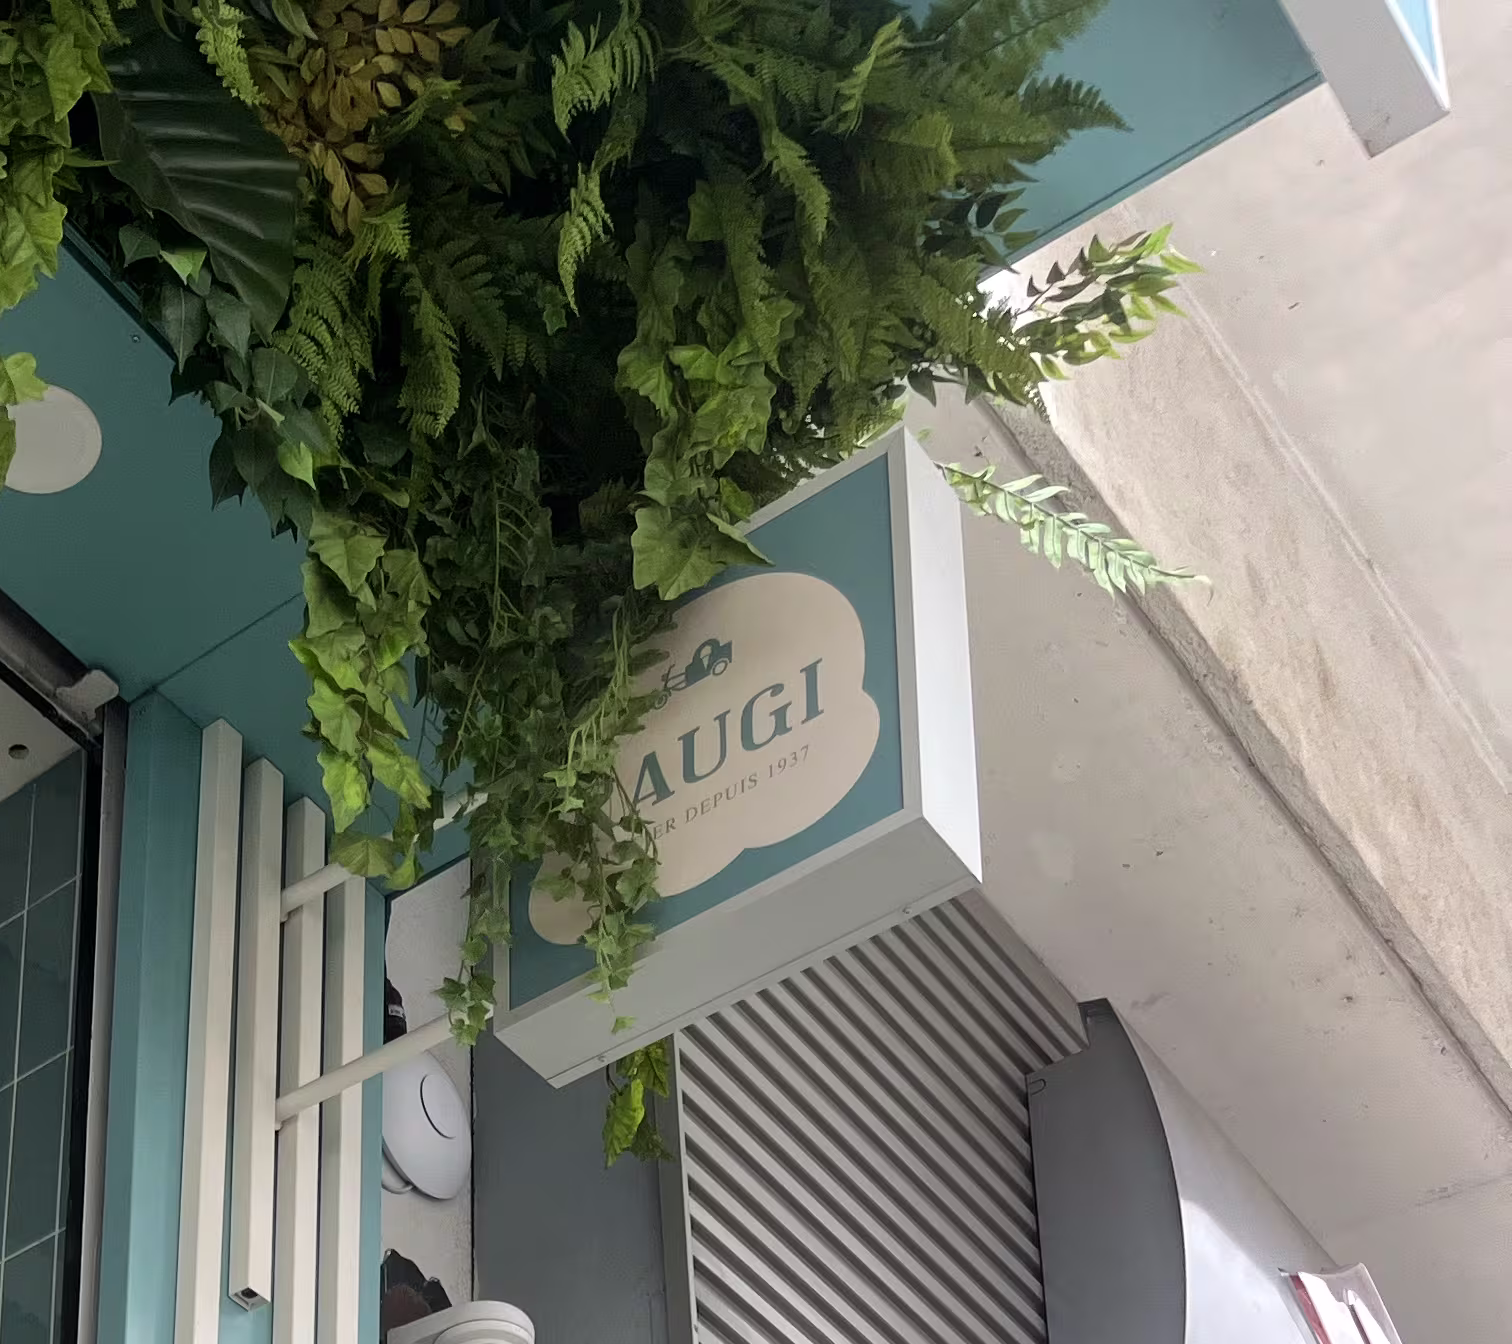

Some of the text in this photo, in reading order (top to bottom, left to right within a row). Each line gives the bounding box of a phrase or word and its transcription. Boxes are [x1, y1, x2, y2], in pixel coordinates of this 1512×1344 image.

[632, 657, 824, 808] AUGI
[685, 771, 759, 824] DEPUIS
[768, 744, 809, 779] 1937
